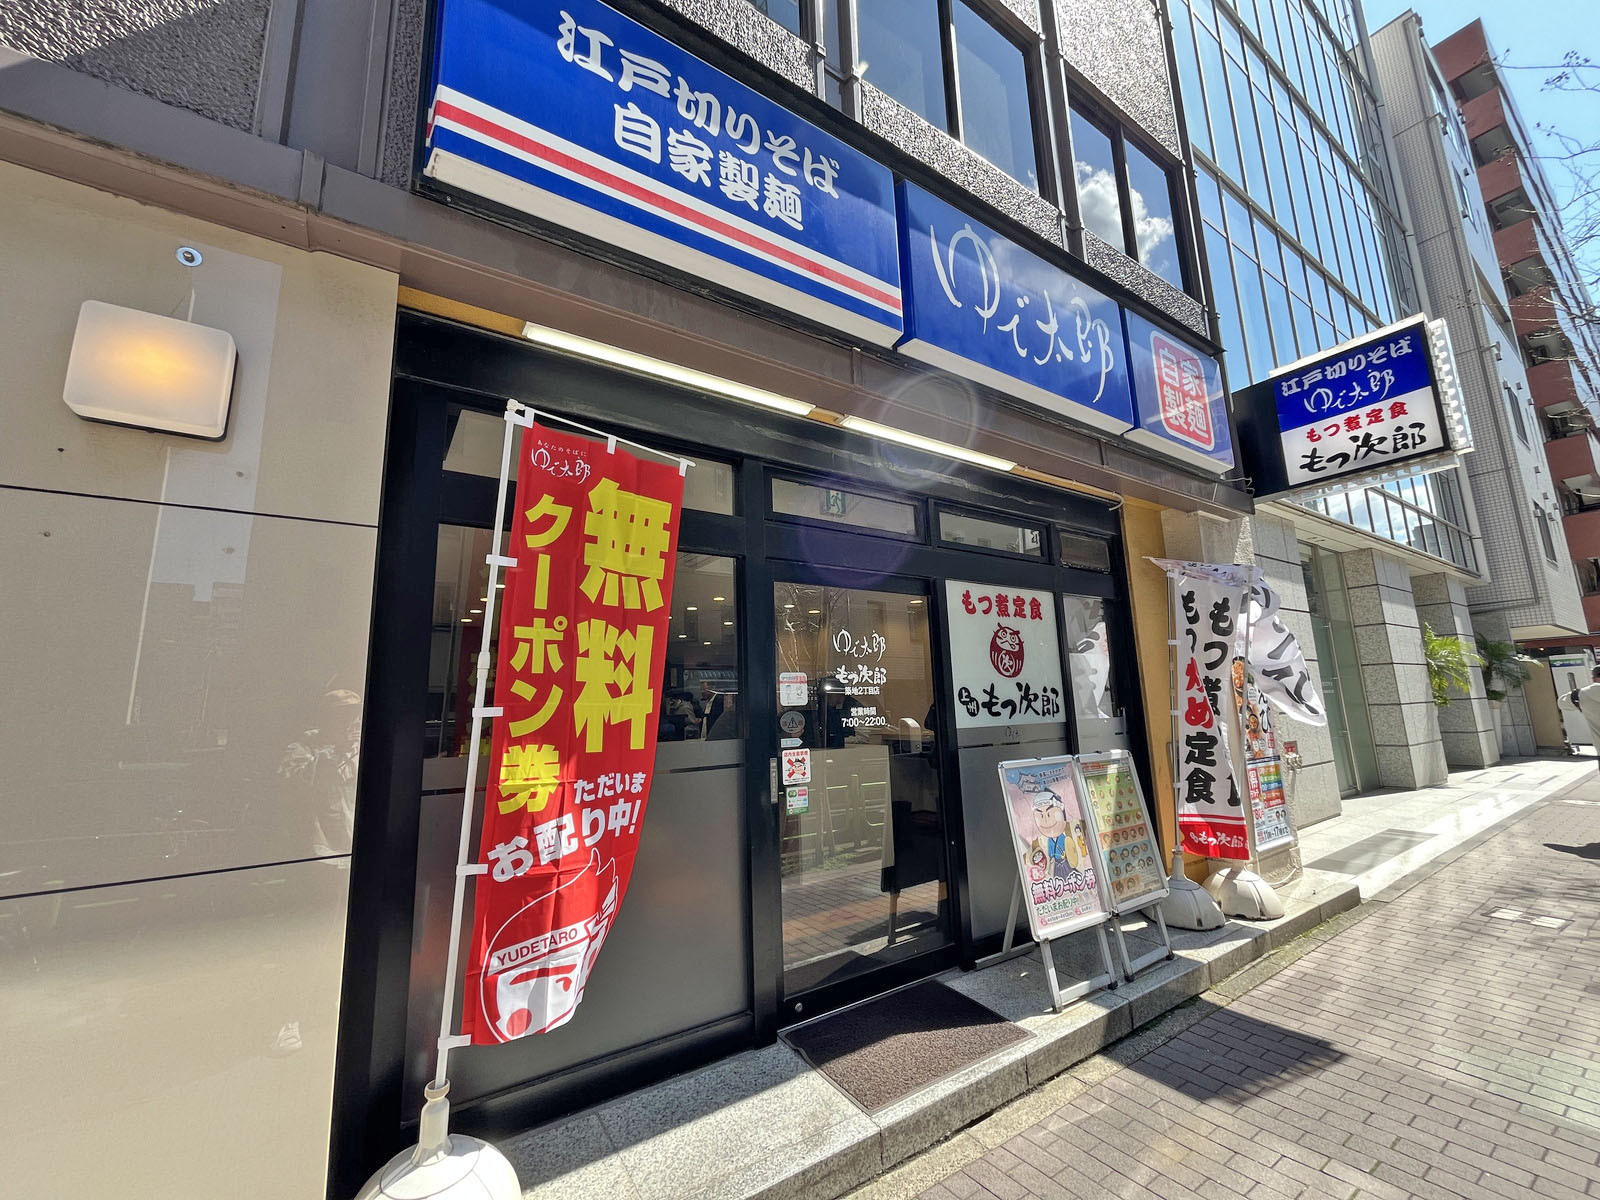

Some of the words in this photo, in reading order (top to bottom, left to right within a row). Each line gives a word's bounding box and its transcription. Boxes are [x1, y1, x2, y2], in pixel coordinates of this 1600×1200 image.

[557, 10, 842, 200] 江戸切りそば
[613, 101, 804, 231] 自家製麺
[929, 222, 1115, 404] ゆで太郎
[1281, 336, 1413, 397] 江戸切りそば
[1303, 368, 1396, 413] ゆで太郎
[1306, 401, 1409, 443] もつ煮定食
[531, 447, 591, 485] ゆで太郎
[537, 439, 588, 457] あなたのそばに
[1299, 422, 1427, 473] もつ次郎
[573, 476, 673, 754] 無料
[961, 589, 1043, 621] もつ煮定食
[497, 492, 574, 816] クーポン券
[832, 628, 887, 662] ゆで太郎
[835, 664, 887, 685] もつ次郎
[850, 707, 877, 716] 営業時間
[981, 682, 1060, 719] もつ次郎
[573, 771, 647, 804] ただいま
[1031, 868, 1096, 905] 無料クーポン券
[496, 927, 579, 967] YUDETARO
